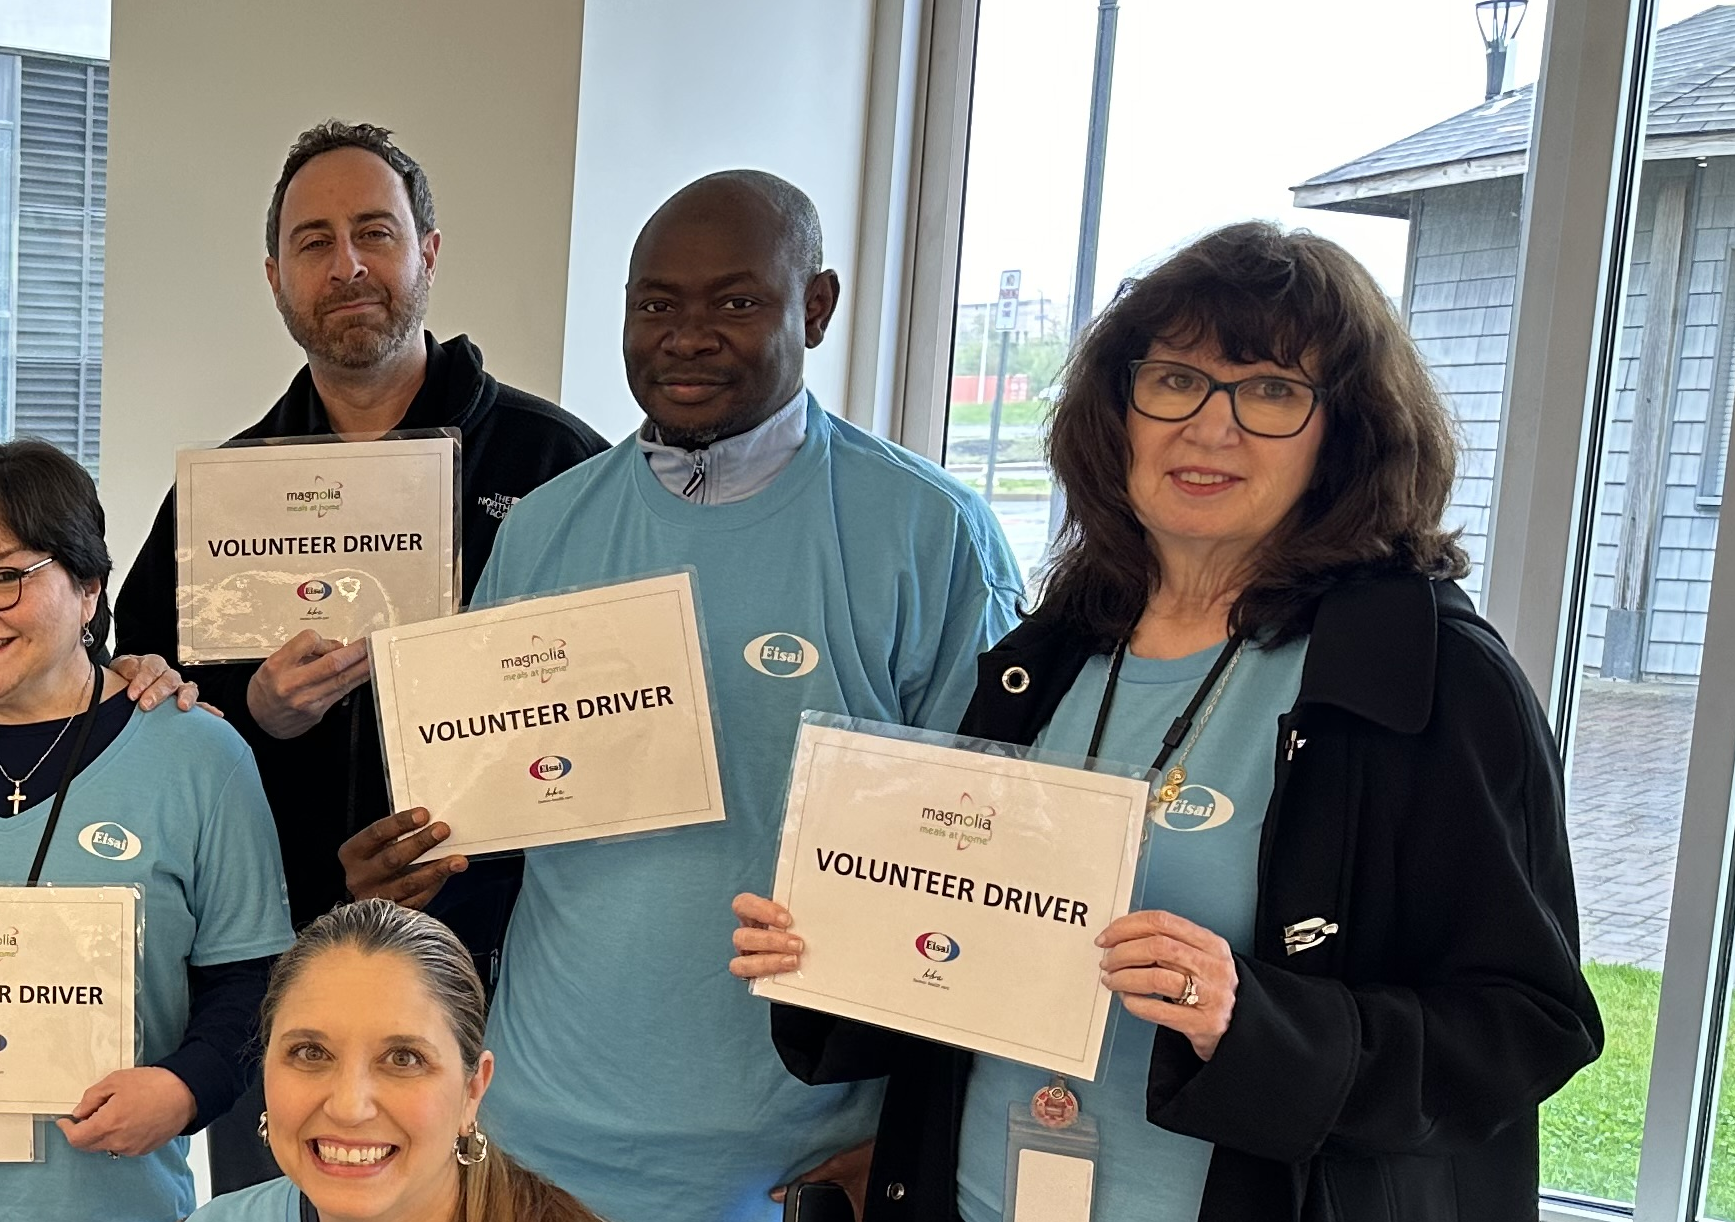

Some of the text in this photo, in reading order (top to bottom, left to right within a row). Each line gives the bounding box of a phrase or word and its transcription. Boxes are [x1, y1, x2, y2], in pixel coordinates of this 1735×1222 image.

[287, 488, 341, 502] magnolia
[208, 533, 422, 557] VOLUNTEER DRIVER
[501, 647, 565, 668] magnolia
[761, 646, 803, 663] Eisai
[418, 685, 674, 744] VOLUNTEER DRIVER
[922, 807, 991, 830] magnolia
[1167, 800, 1215, 817] Eisai
[93, 831, 127, 850] Eisai
[816, 847, 1089, 927] VOLUNTEER DRIVER
[19, 985, 104, 1005] DRIVER
